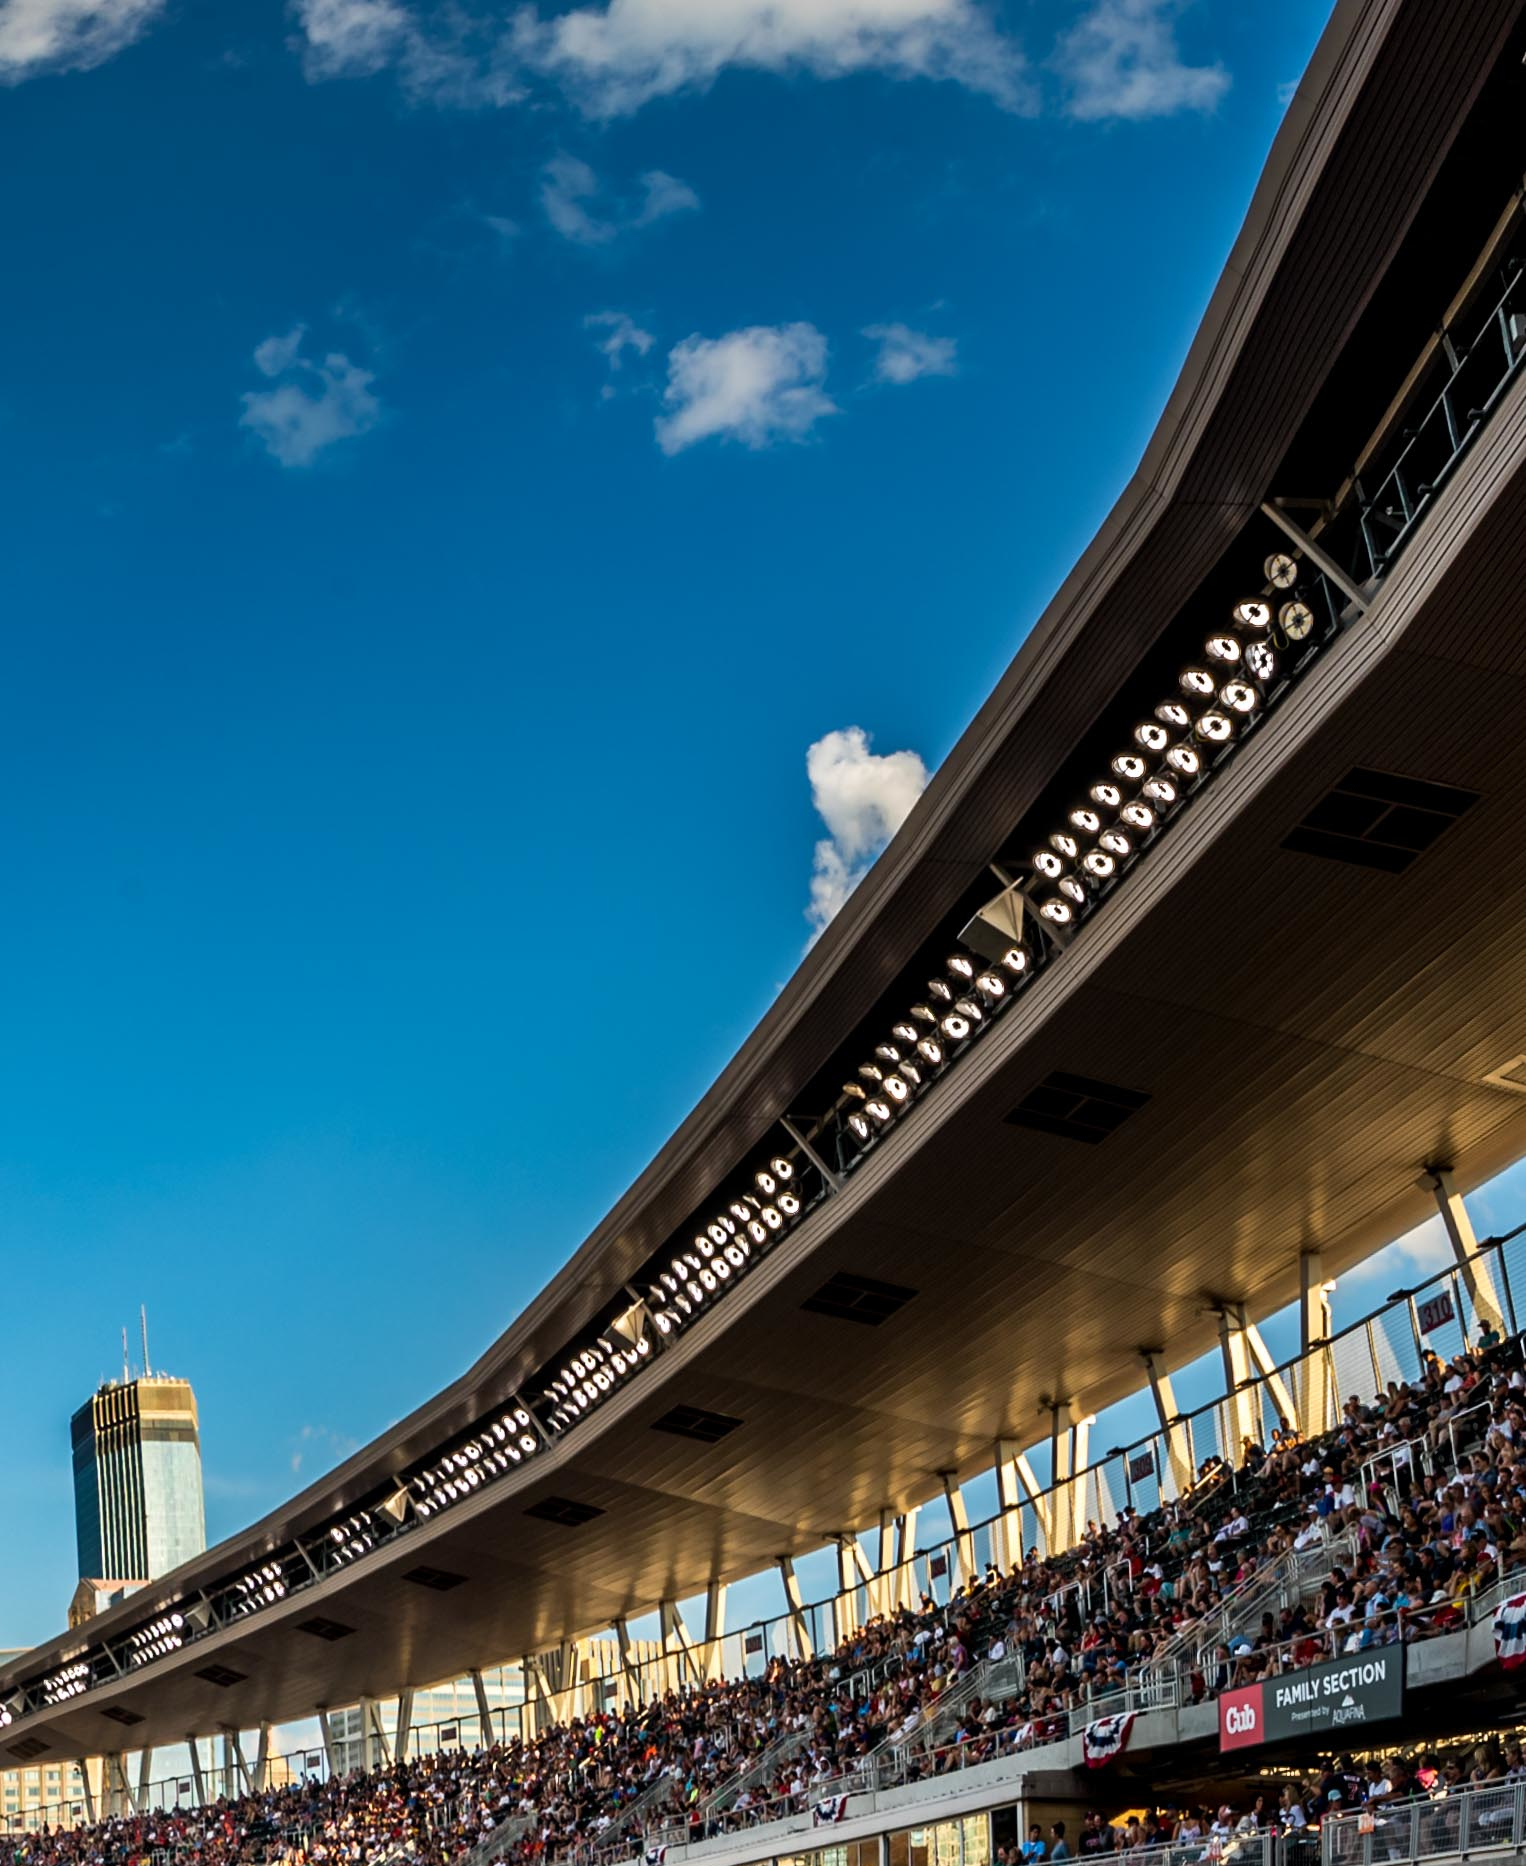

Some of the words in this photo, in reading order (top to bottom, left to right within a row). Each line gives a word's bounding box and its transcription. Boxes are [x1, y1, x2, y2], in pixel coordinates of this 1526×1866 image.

[1276, 1679, 1320, 1709] FAMILY
[1324, 1660, 1386, 1697] SECTION
[1226, 1704, 1255, 1734] Cub
[1291, 1709, 1321, 1721] Presented
[1322, 1706, 1330, 1717] by
[1332, 1704, 1366, 1726] AQUAFINA
